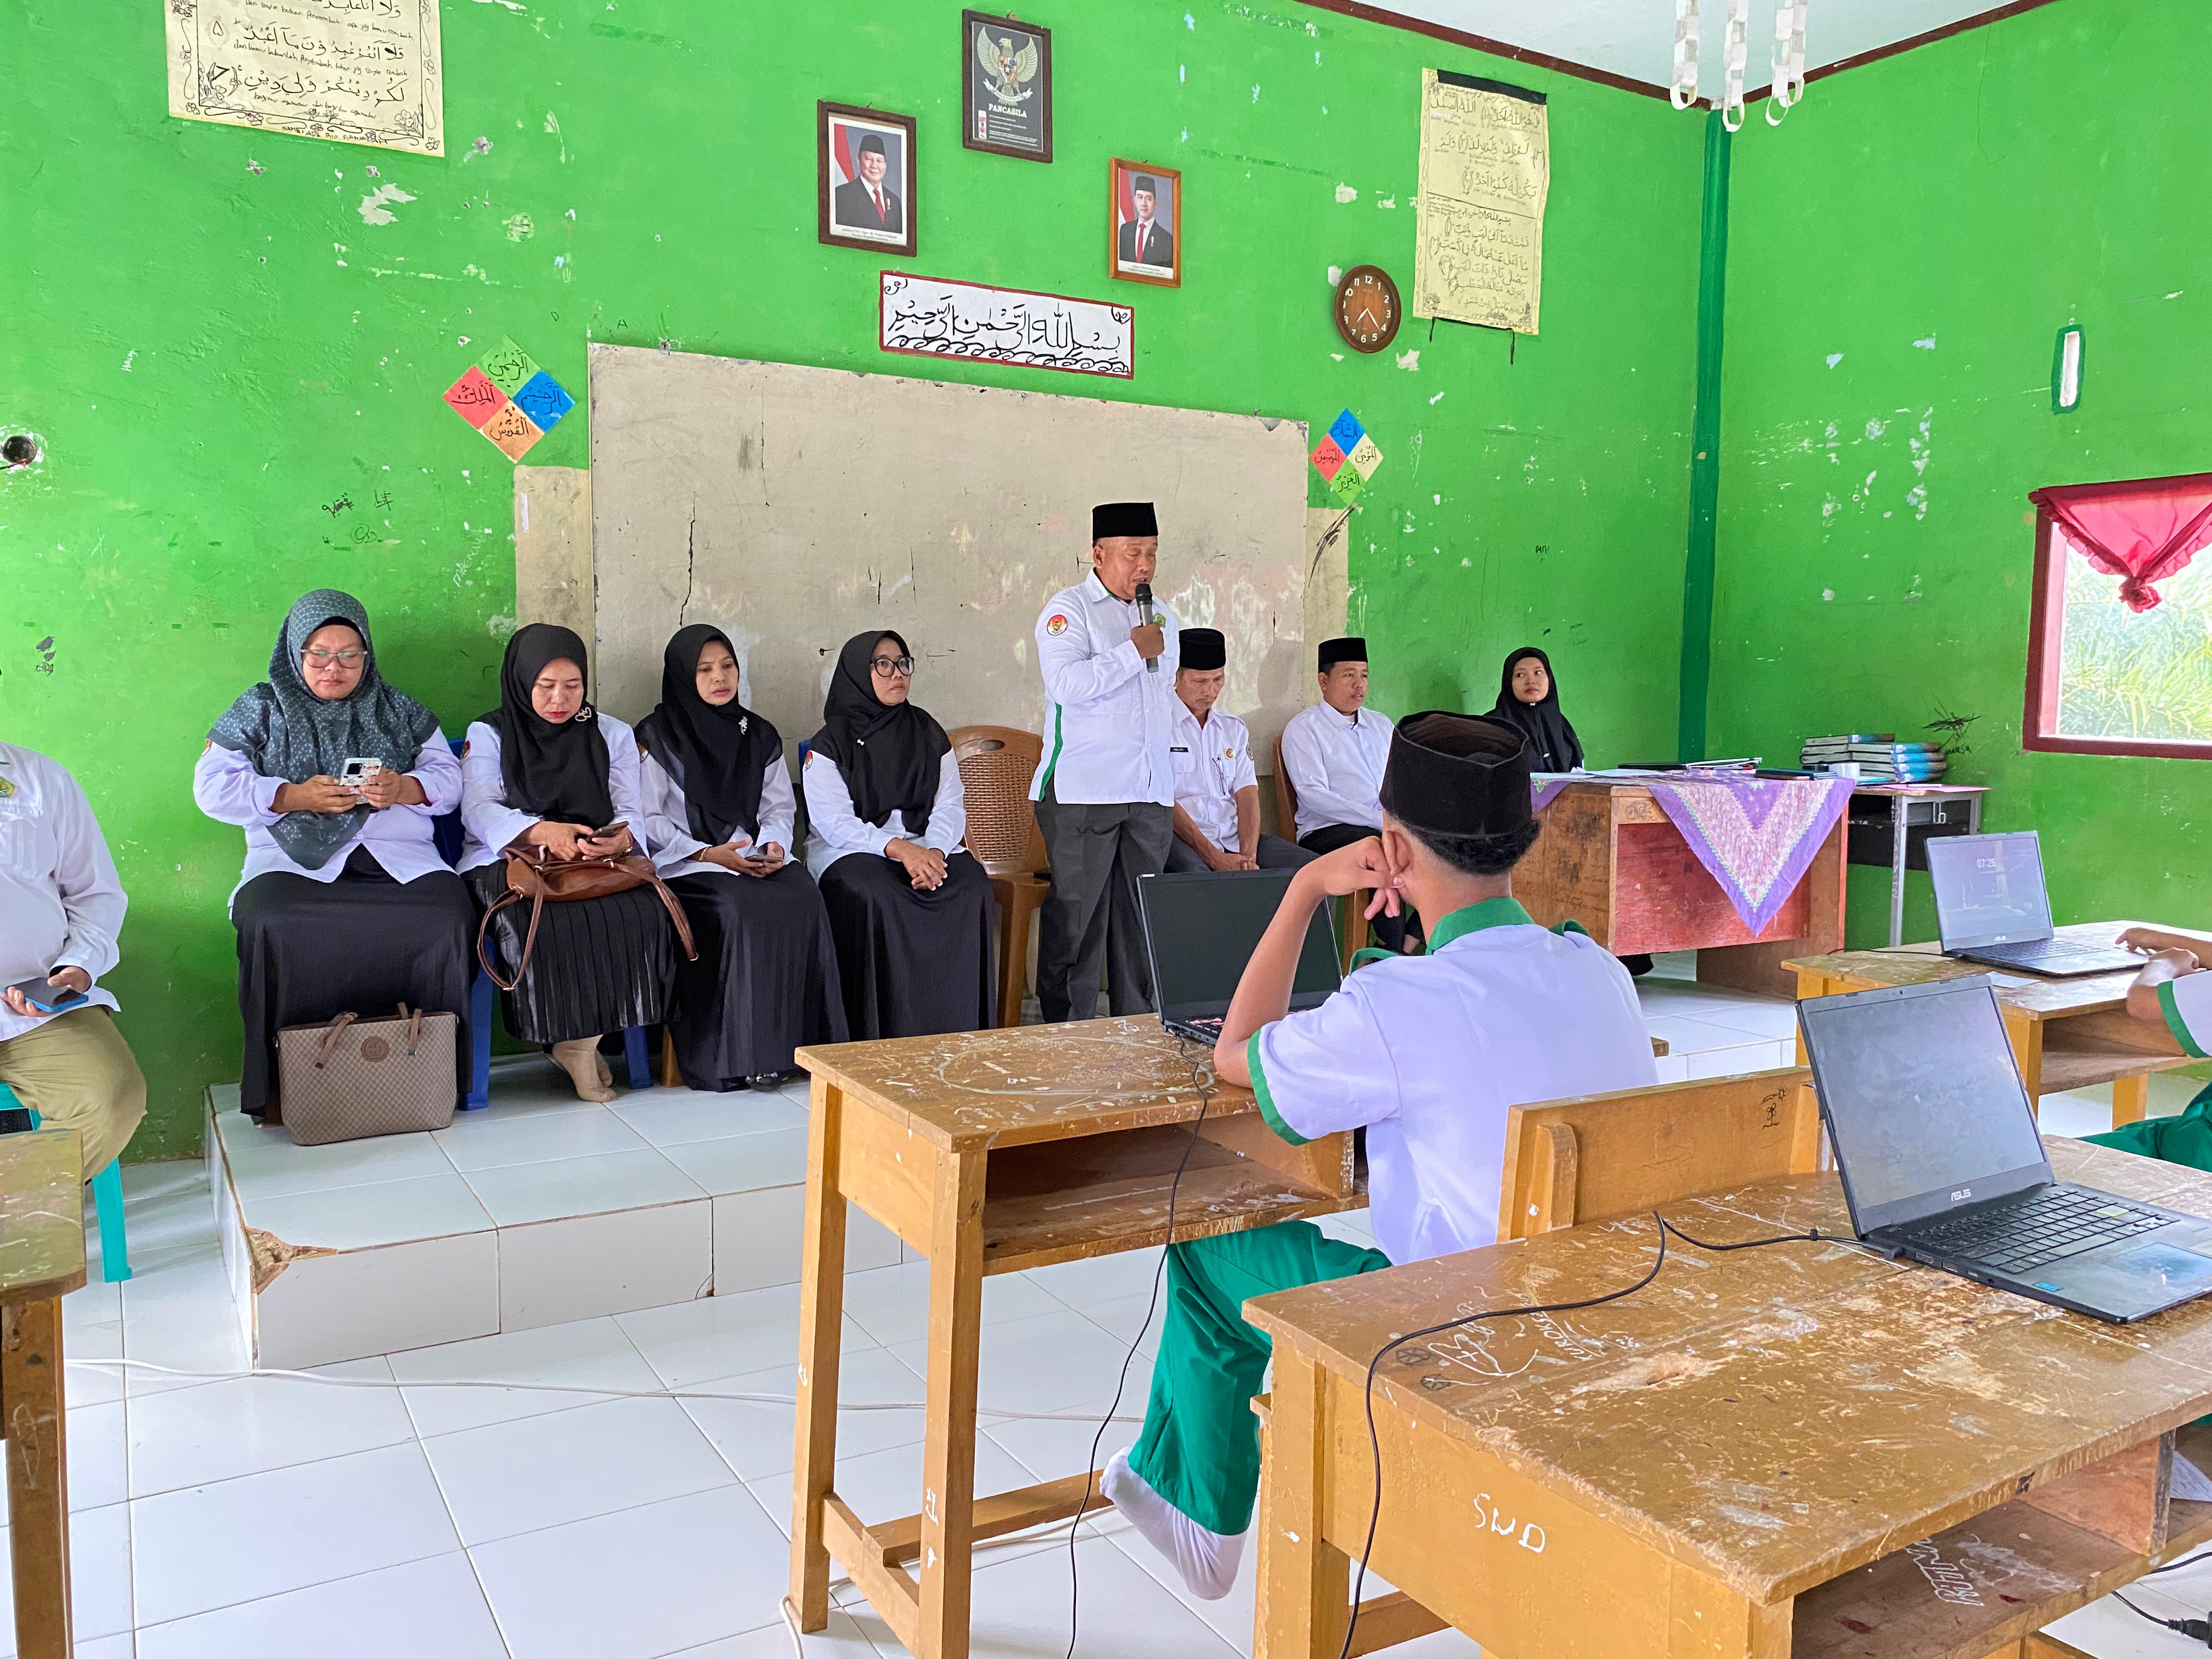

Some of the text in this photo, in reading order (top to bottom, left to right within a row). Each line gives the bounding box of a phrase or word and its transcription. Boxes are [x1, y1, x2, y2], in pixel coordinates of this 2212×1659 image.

[988, 103, 1028, 118] PANCASILA
[1365, 275, 1373, 284] 12
[1378, 282, 1381, 290] 1
[1384, 295, 1389, 303] 2
[1386, 309, 1391, 318] 3
[1381, 323, 1386, 332] 4
[1361, 335, 1367, 343] 6
[1372, 333, 1378, 341] 5
[1976, 857, 1997, 869] 07:26
[1951, 1188, 1972, 1201] ASUS
